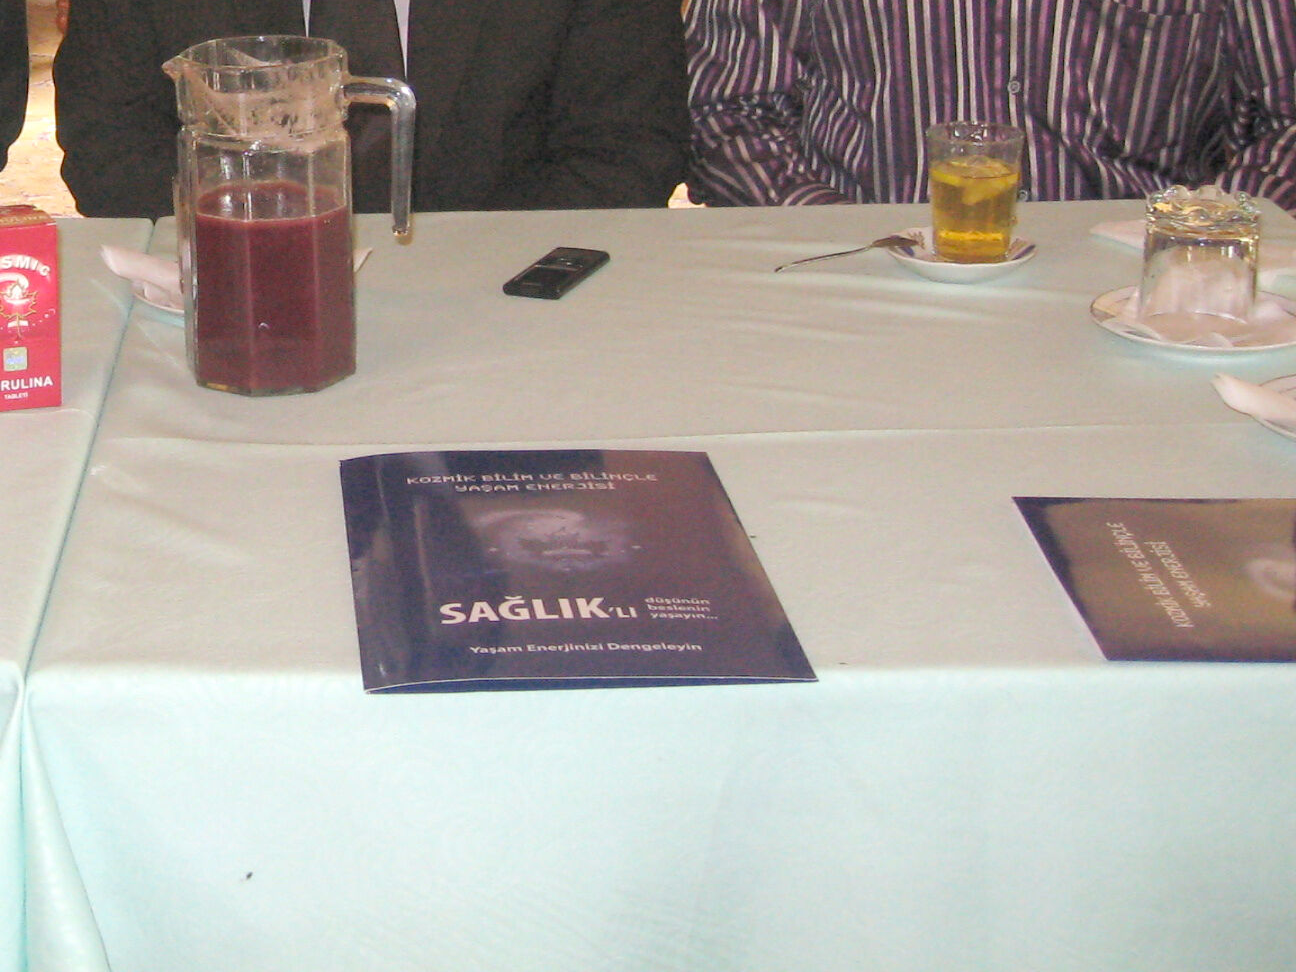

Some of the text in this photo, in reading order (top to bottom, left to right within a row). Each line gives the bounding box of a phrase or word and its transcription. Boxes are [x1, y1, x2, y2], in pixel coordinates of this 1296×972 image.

[406, 473, 478, 485] KOZMİK
[481, 472, 533, 482] BİLİM
[570, 471, 658, 482] BİLİNÇLE
[455, 481, 616, 493] YAŞAM ENERJİSİ
[469, 641, 703, 655] Yaşam Enerjinizi Dengeleyin
